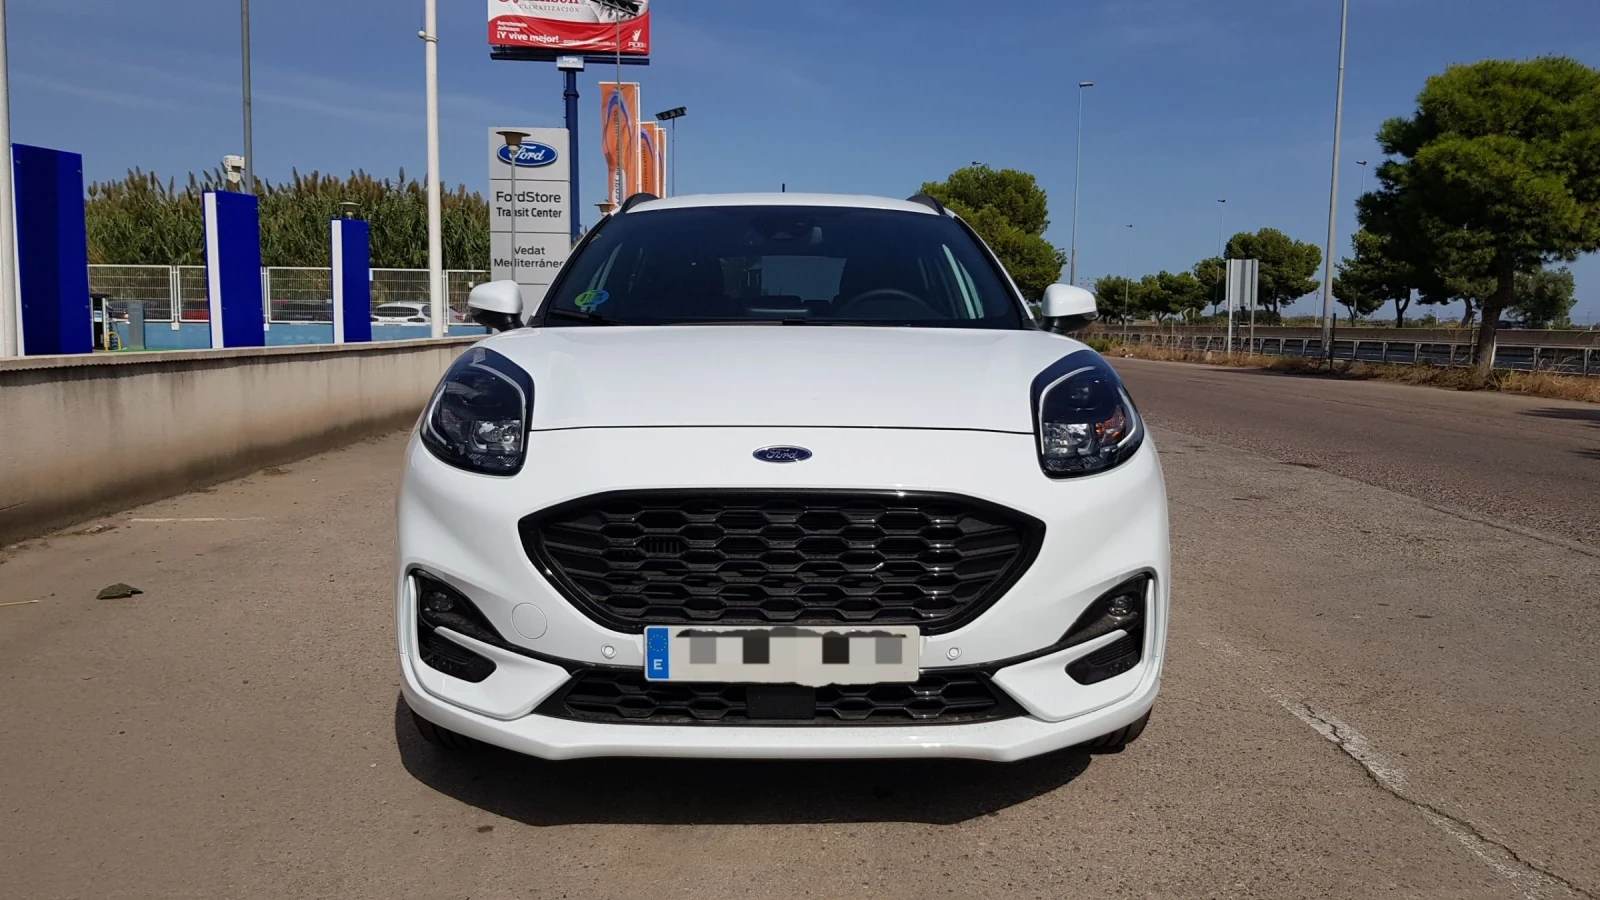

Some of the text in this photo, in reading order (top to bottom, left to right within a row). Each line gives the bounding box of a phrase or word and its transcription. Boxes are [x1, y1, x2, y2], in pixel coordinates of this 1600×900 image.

[518, 3, 580, 13] CLIMATIZACIÓN
[508, 32, 529, 41] vive
[529, 34, 559, 44] mejor!
[509, 144, 546, 161] Ford
[531, 207, 563, 218] Center
[514, 245, 546, 255] Vedat
[765, 448, 799, 459] Ford
[653, 658, 663, 670] E
